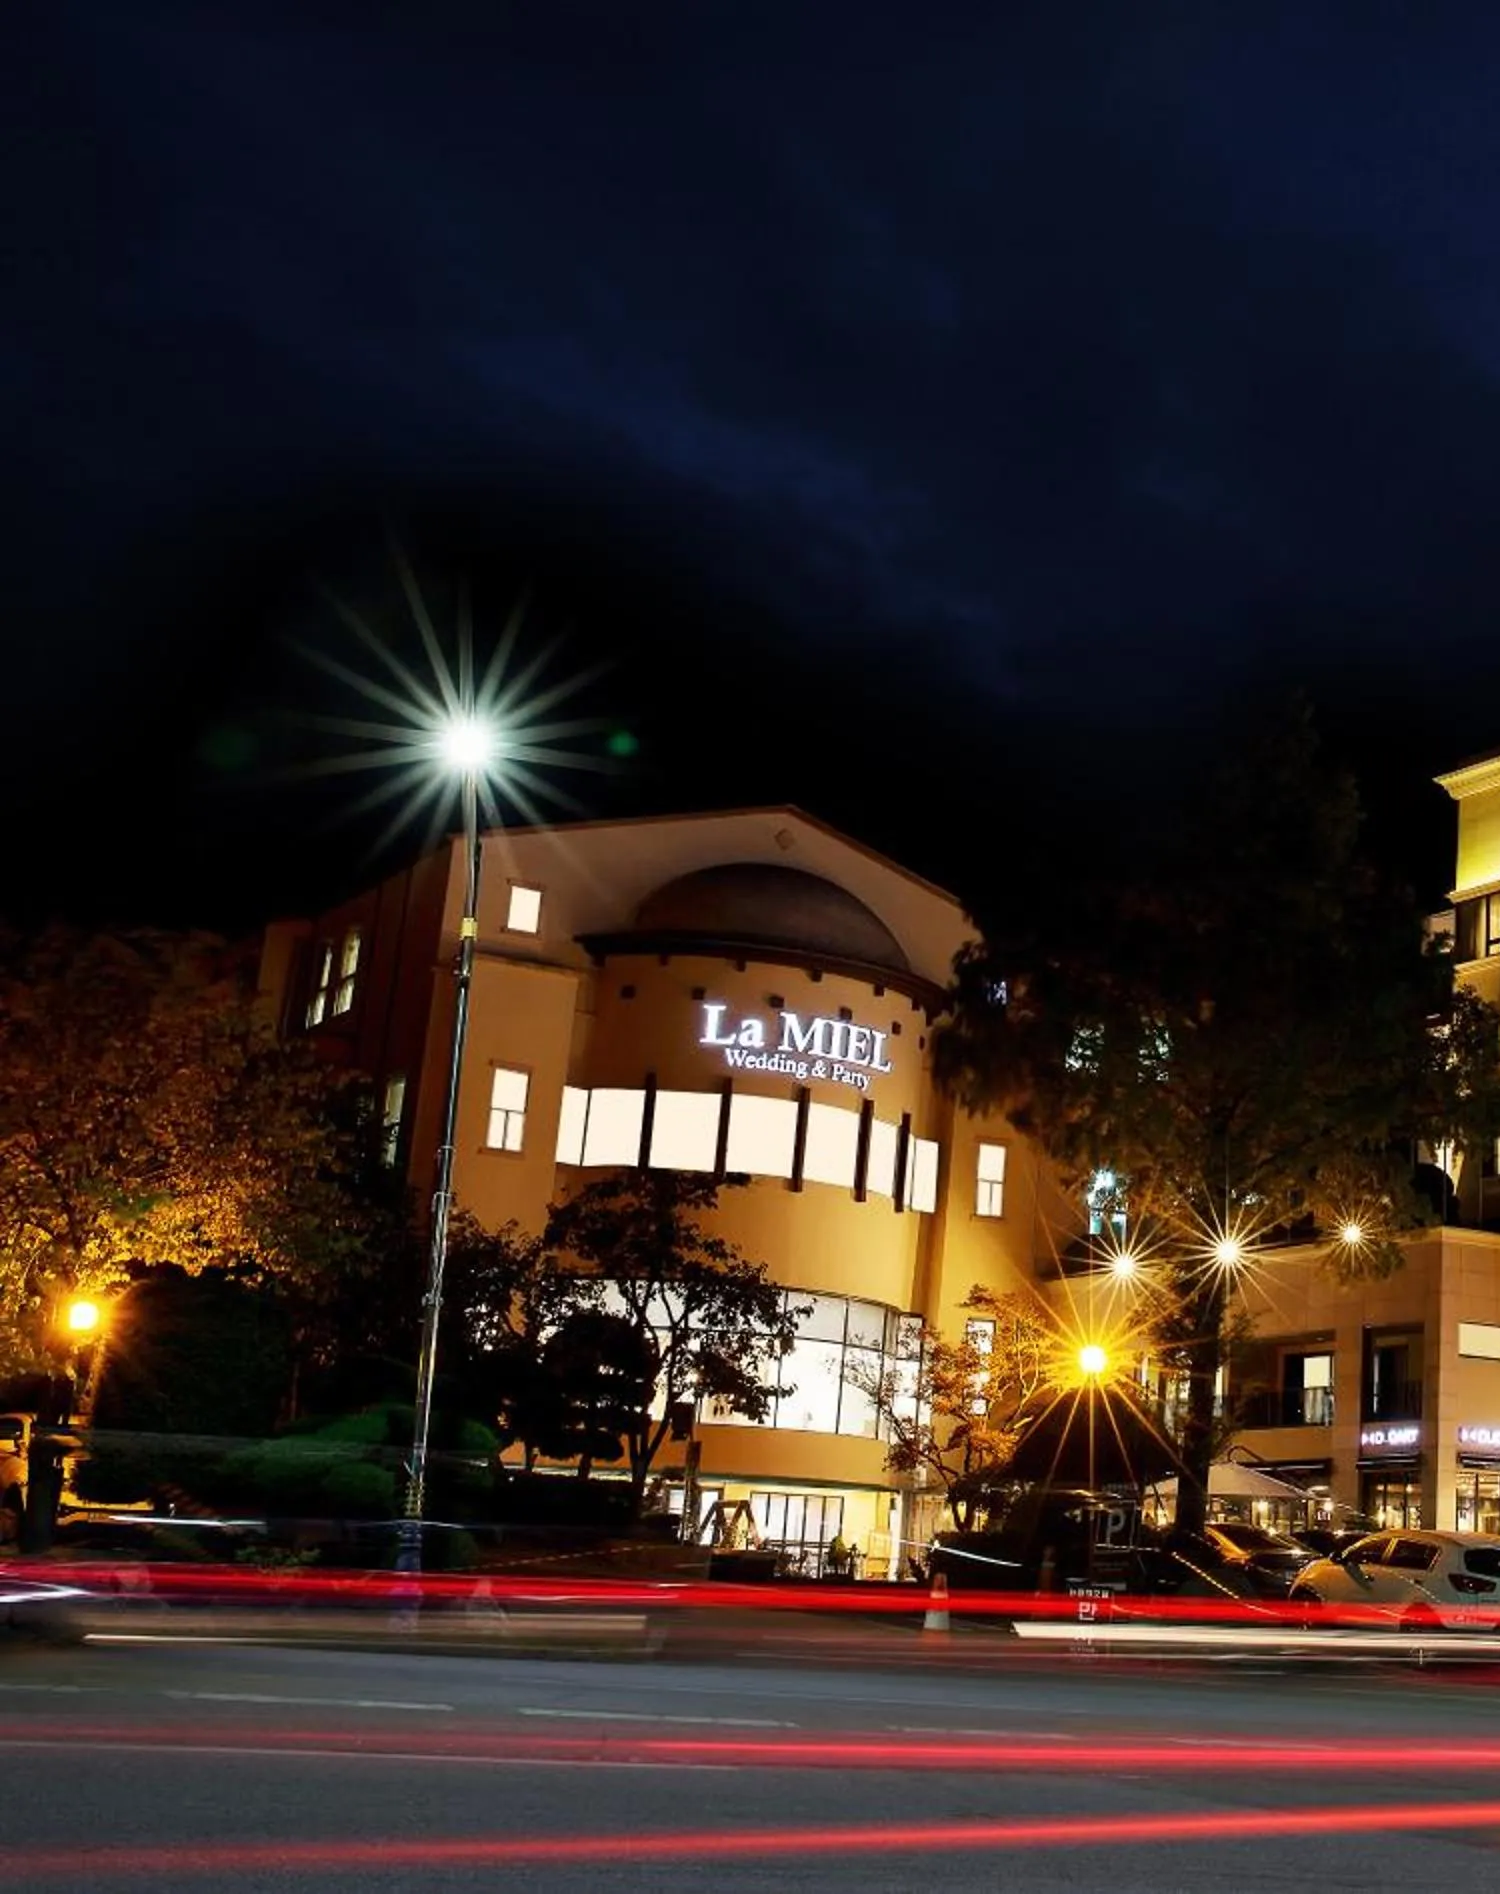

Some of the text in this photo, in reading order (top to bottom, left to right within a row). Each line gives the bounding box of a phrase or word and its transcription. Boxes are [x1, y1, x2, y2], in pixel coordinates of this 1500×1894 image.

[700, 1003, 893, 1073] La MIEL
[724, 1047, 872, 1092] Wedding & Party
